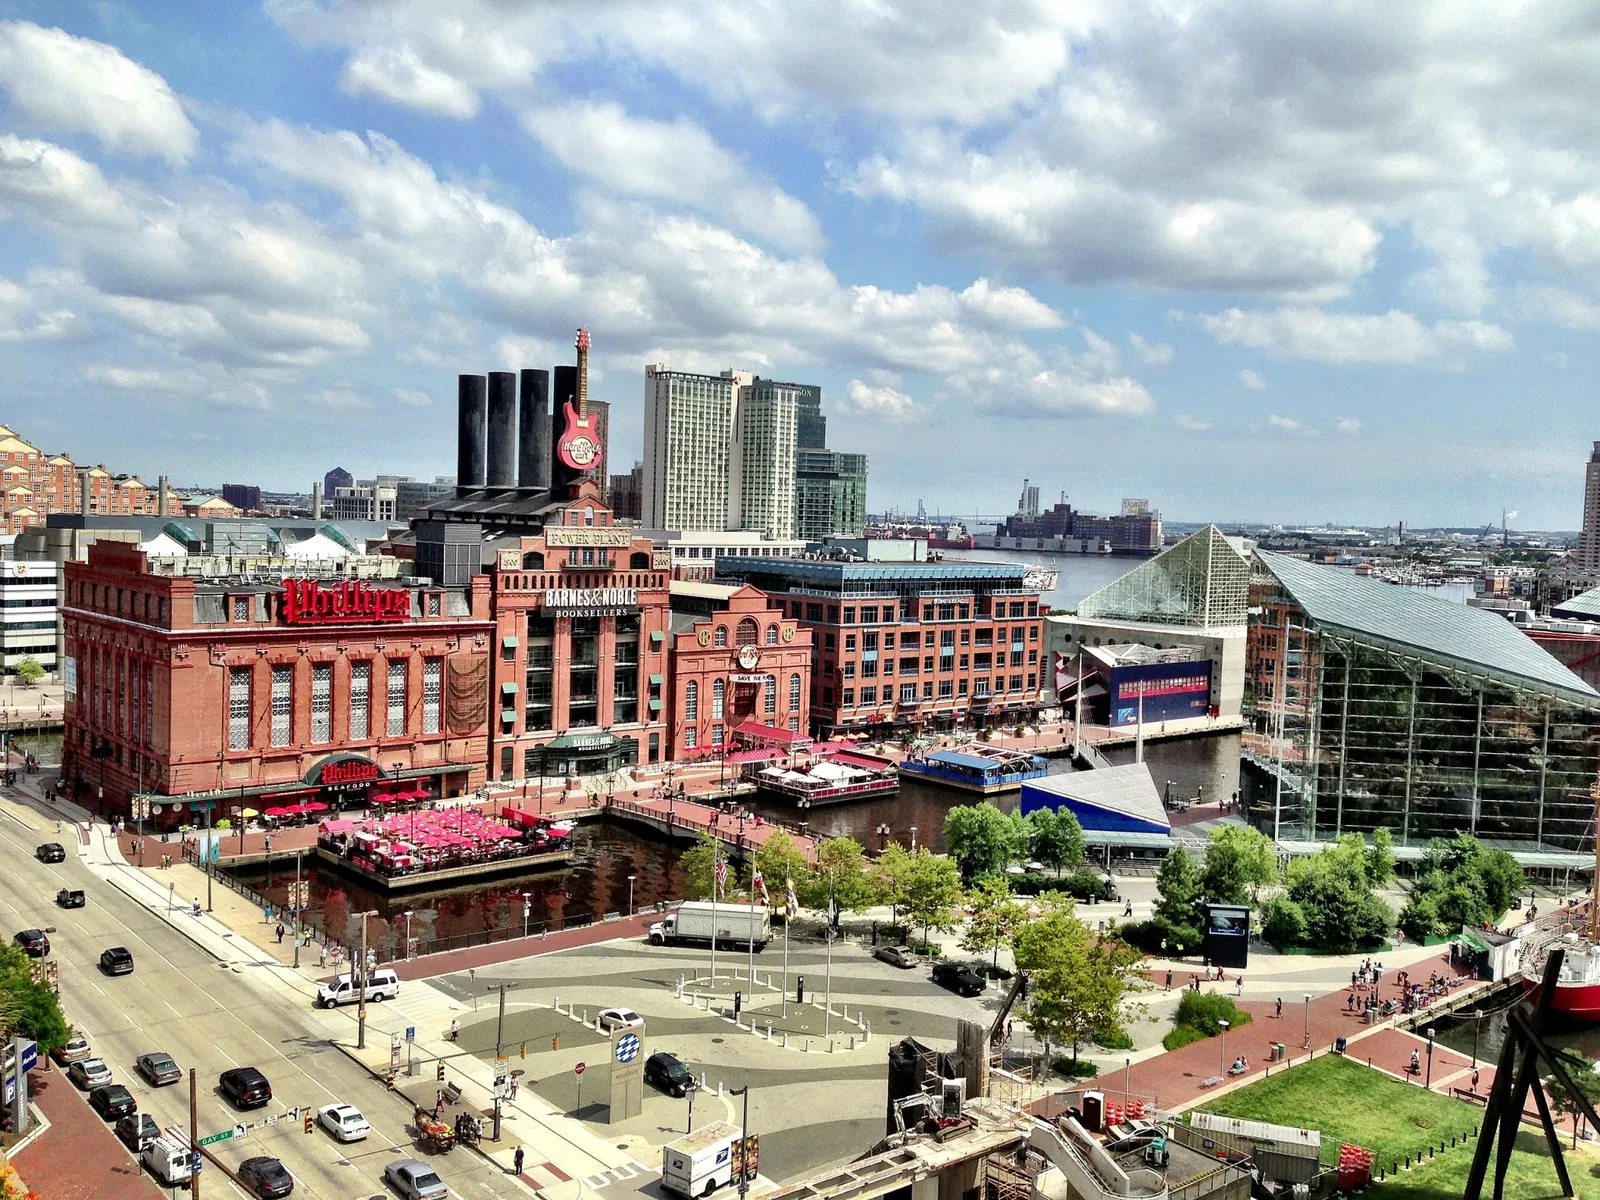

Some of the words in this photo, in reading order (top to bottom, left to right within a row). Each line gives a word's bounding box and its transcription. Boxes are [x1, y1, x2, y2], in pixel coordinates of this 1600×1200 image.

[551, 533, 589, 545] POWER
[593, 533, 629, 545] PLANT
[281, 578, 411, 623] Phillips
[555, 608, 628, 618] BOOKSELLERS
[322, 761, 379, 784] Phillips
[328, 782, 370, 791] SEAFOOD
[202, 1135, 218, 1146] GAY
[220, 1132, 229, 1141] ST
